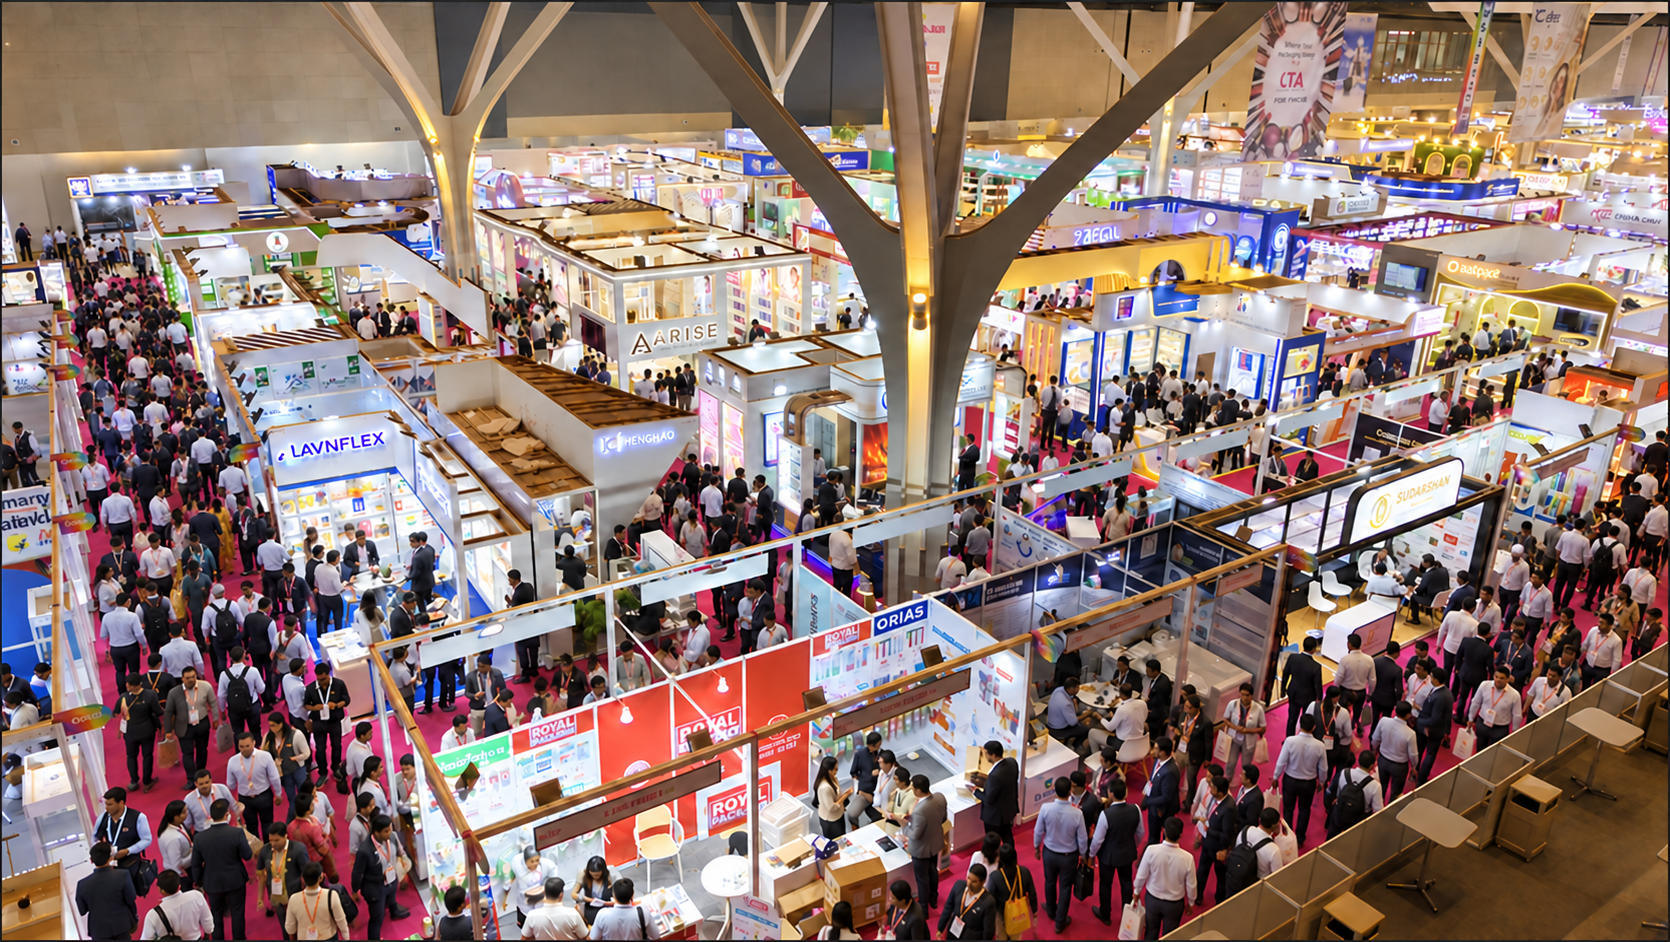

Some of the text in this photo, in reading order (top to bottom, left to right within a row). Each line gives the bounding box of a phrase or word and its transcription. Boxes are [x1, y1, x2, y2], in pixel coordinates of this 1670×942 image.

[1280, 71, 1304, 88] CTA
[290, 431, 385, 458] LAVNFLEX
[624, 430, 675, 447] HENGHAO
[1396, 474, 1451, 505] SUDARSHAN
[876, 605, 924, 631] ORIAS
[532, 716, 575, 739] ROYAL
[712, 787, 768, 817] ROYL
